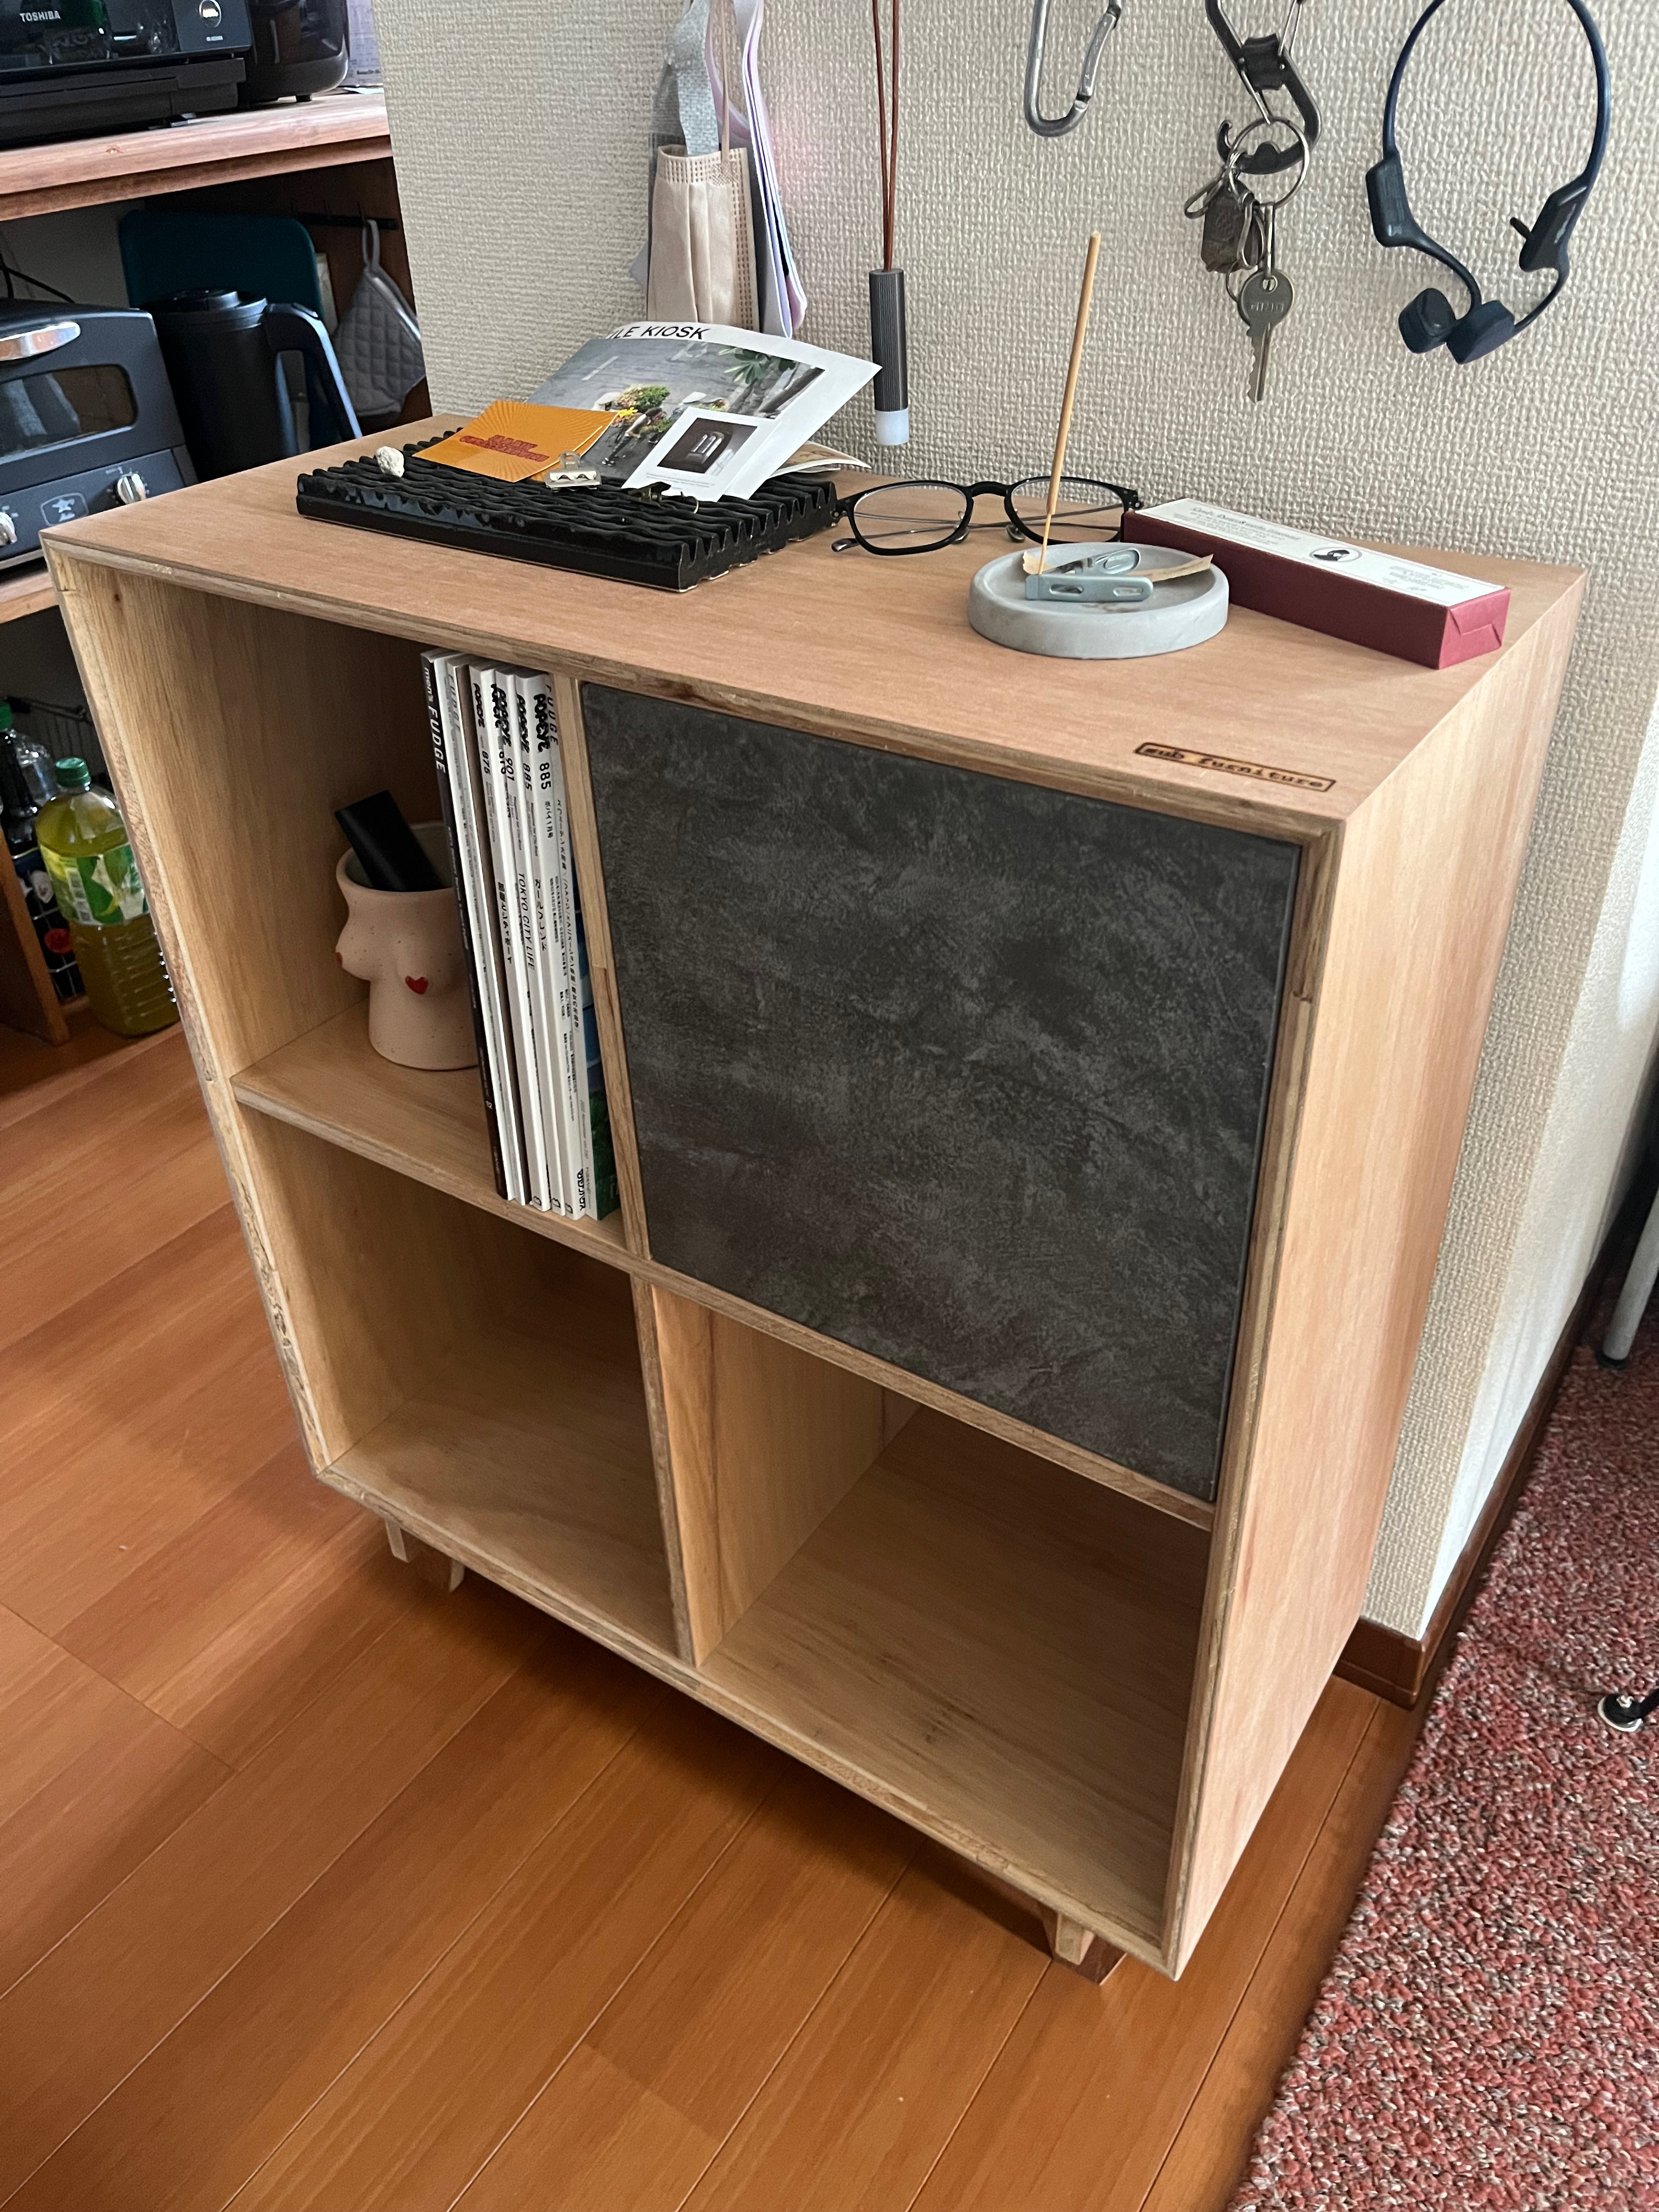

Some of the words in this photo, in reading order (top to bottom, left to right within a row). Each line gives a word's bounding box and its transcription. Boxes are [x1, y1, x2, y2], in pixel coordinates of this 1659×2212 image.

[20, 10, 61, 22] TOSHIBA
[640, 326, 710, 340] KIOSK
[534, 693, 550, 753] POPEYE
[428, 706, 445, 774] FUDGE
[506, 758, 515, 781] 901
[523, 763, 532, 791] 885
[539, 762, 551, 790] 885
[1197, 758, 1323, 787] furniture
[518, 873, 528, 911] TOKYO
[523, 916, 532, 942] CITY
[526, 946, 535, 970] LIFE
